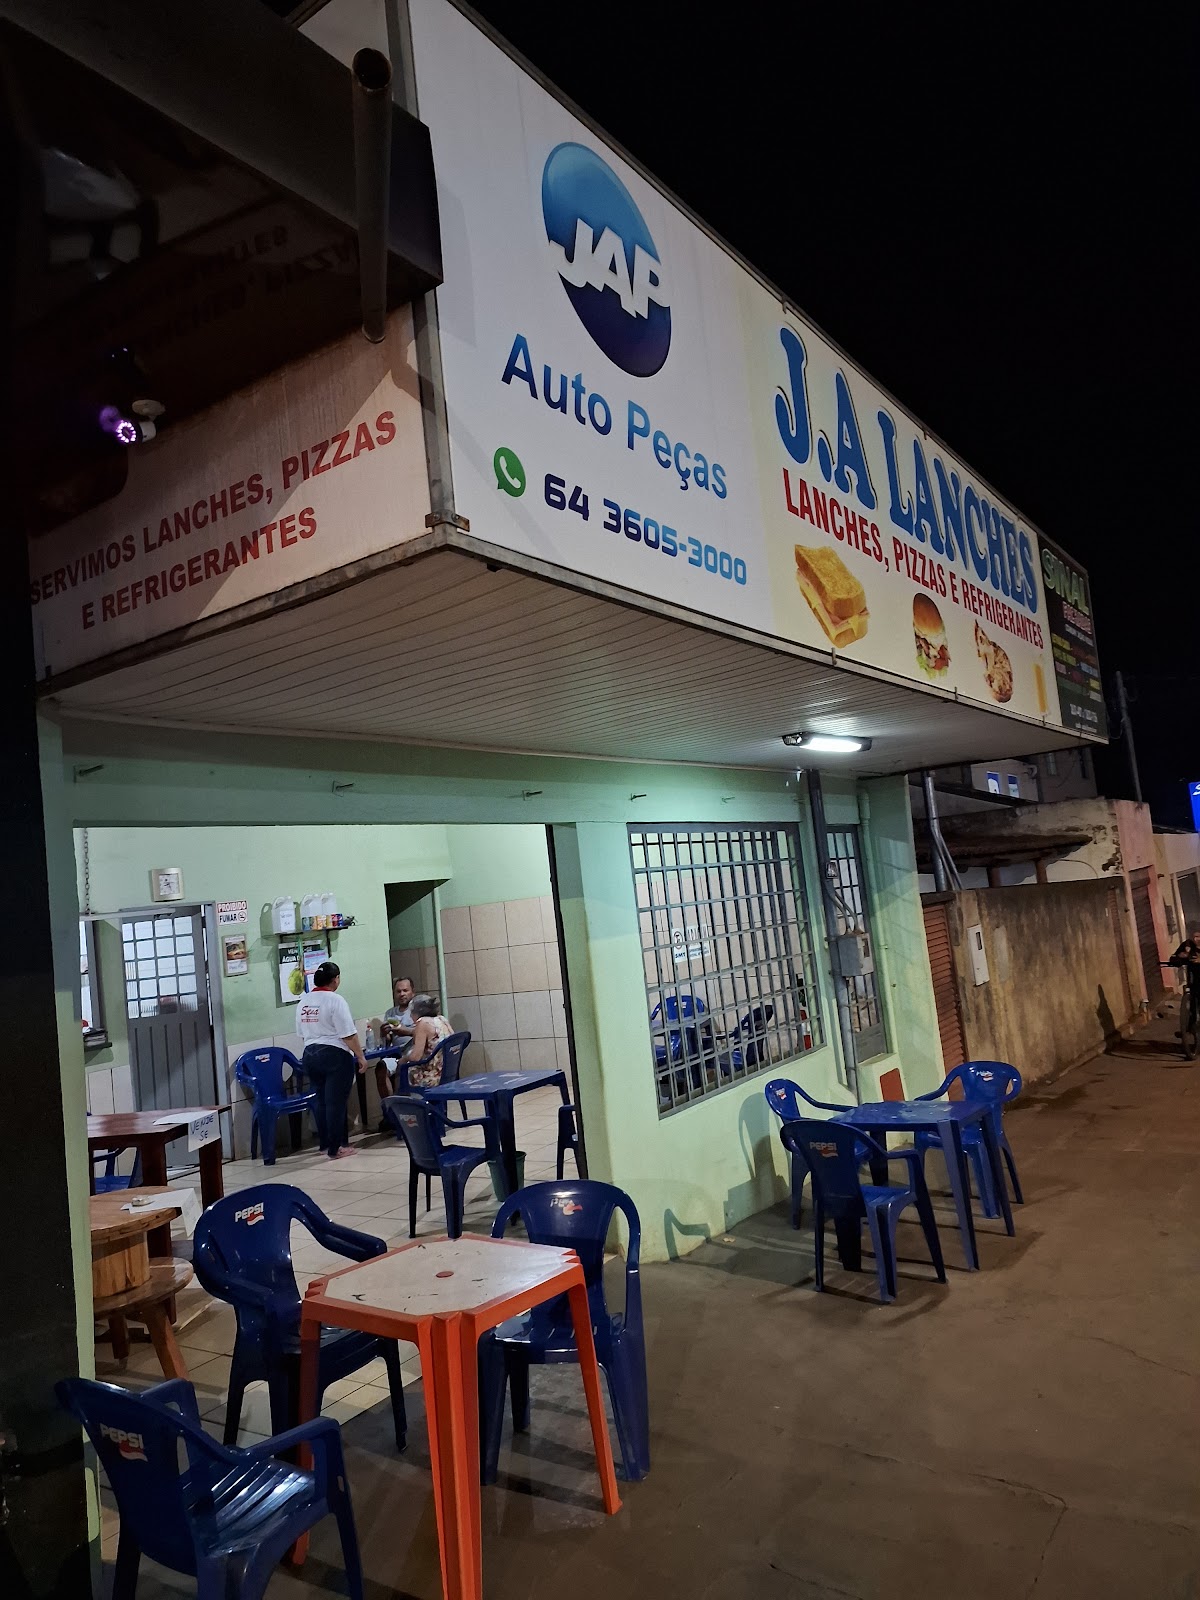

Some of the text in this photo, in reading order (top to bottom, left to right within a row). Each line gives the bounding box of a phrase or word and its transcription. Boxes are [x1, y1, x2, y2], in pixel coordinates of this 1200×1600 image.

[549, 218, 671, 319] JAP
[501, 333, 728, 501] Auto Peças
[31, 410, 398, 606] SERVIMOS LANCHES, PIZZAS
[544, 473, 747, 586] 64 3605-3000
[877, 409, 1039, 614] LANCHES
[82, 506, 319, 631] E REFRIGERANTES
[782, 468, 891, 572] LANCHES,
[893, 536, 948, 598] PIZZAS
[949, 572, 960, 604] E
[961, 579, 1044, 650] REFRIGERANTES
[1041, 548, 1090, 616] SINAL
[218, 901, 247, 913] PROIBIDO
[219, 913, 238, 923] FUMAR
[190, 1114, 214, 1135] VENDE
[199, 1129, 209, 1142] SE
[809, 1140, 837, 1151] PEPSI
[235, 1202, 264, 1222] PEPSI
[99, 1422, 144, 1449] PEPSI
